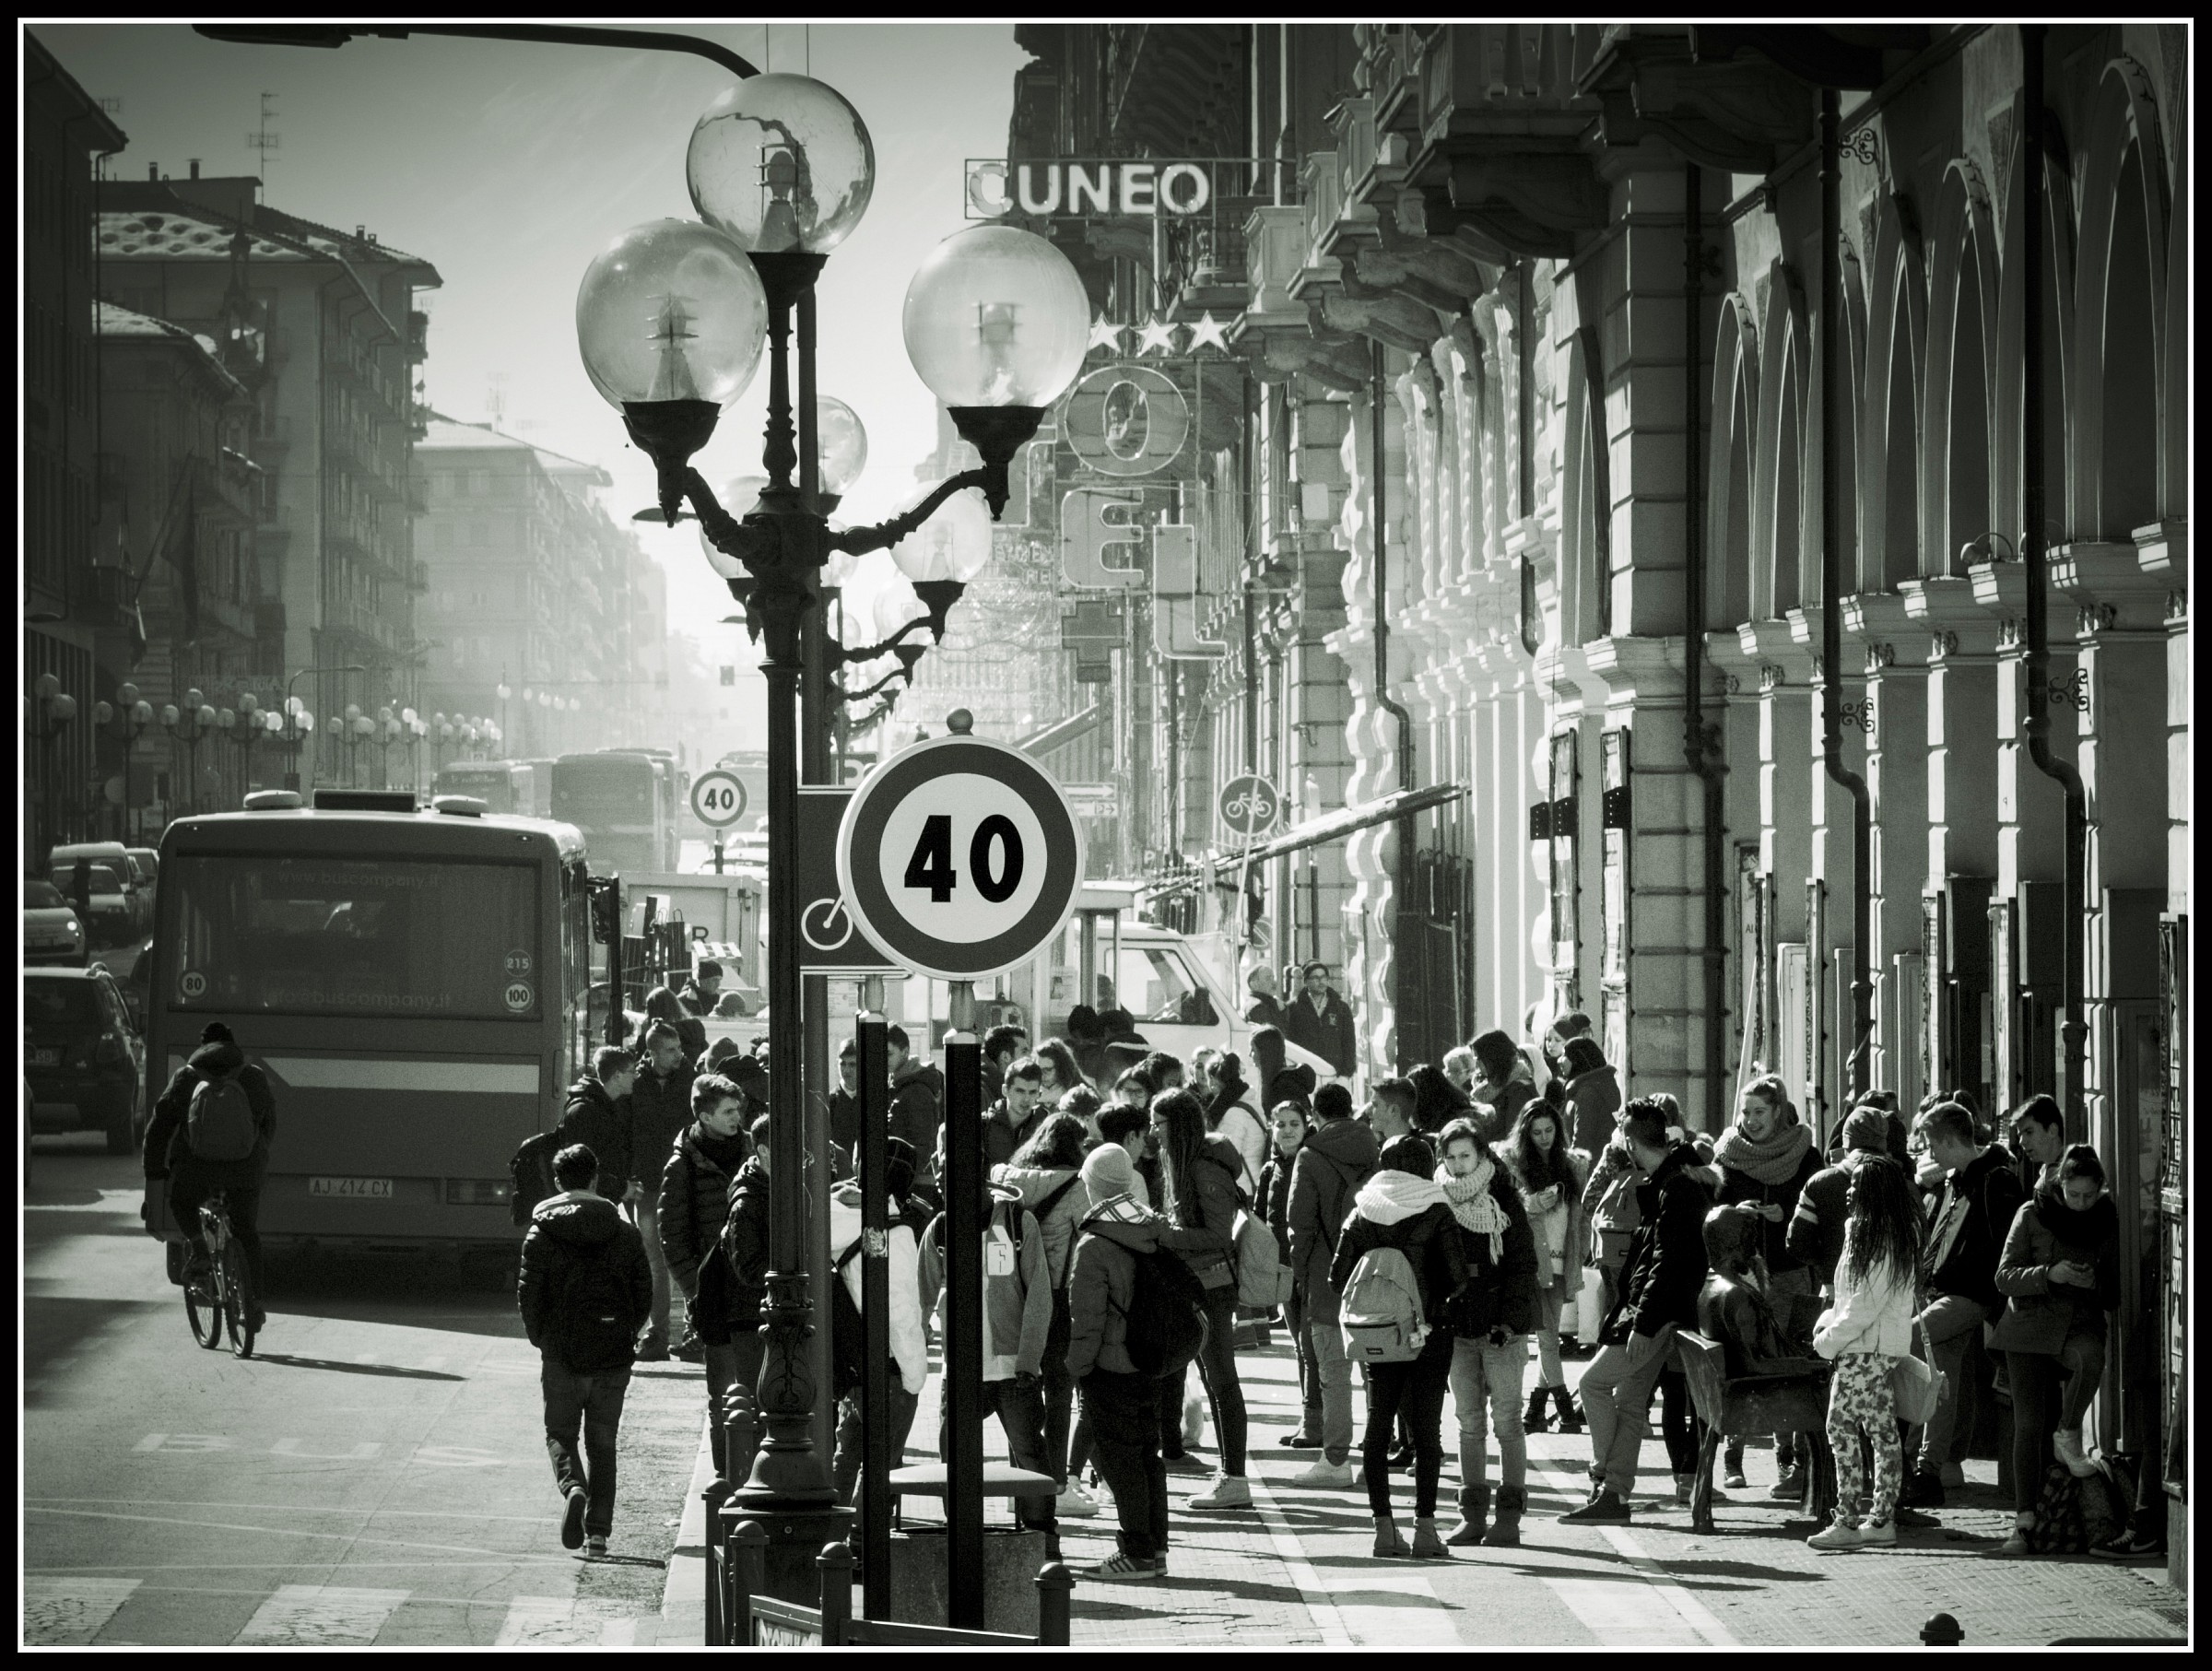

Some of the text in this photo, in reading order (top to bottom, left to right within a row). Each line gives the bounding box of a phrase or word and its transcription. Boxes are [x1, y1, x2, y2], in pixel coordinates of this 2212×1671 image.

[969, 161, 1210, 216] CUNEO
[703, 787, 735, 810] 40
[903, 813, 1024, 903] 40
[506, 957, 529, 971] 215
[185, 975, 203, 993] 80
[508, 989, 529, 1003] 100
[339, 1180, 366, 1195] 414
[371, 1181, 389, 1195] CX
